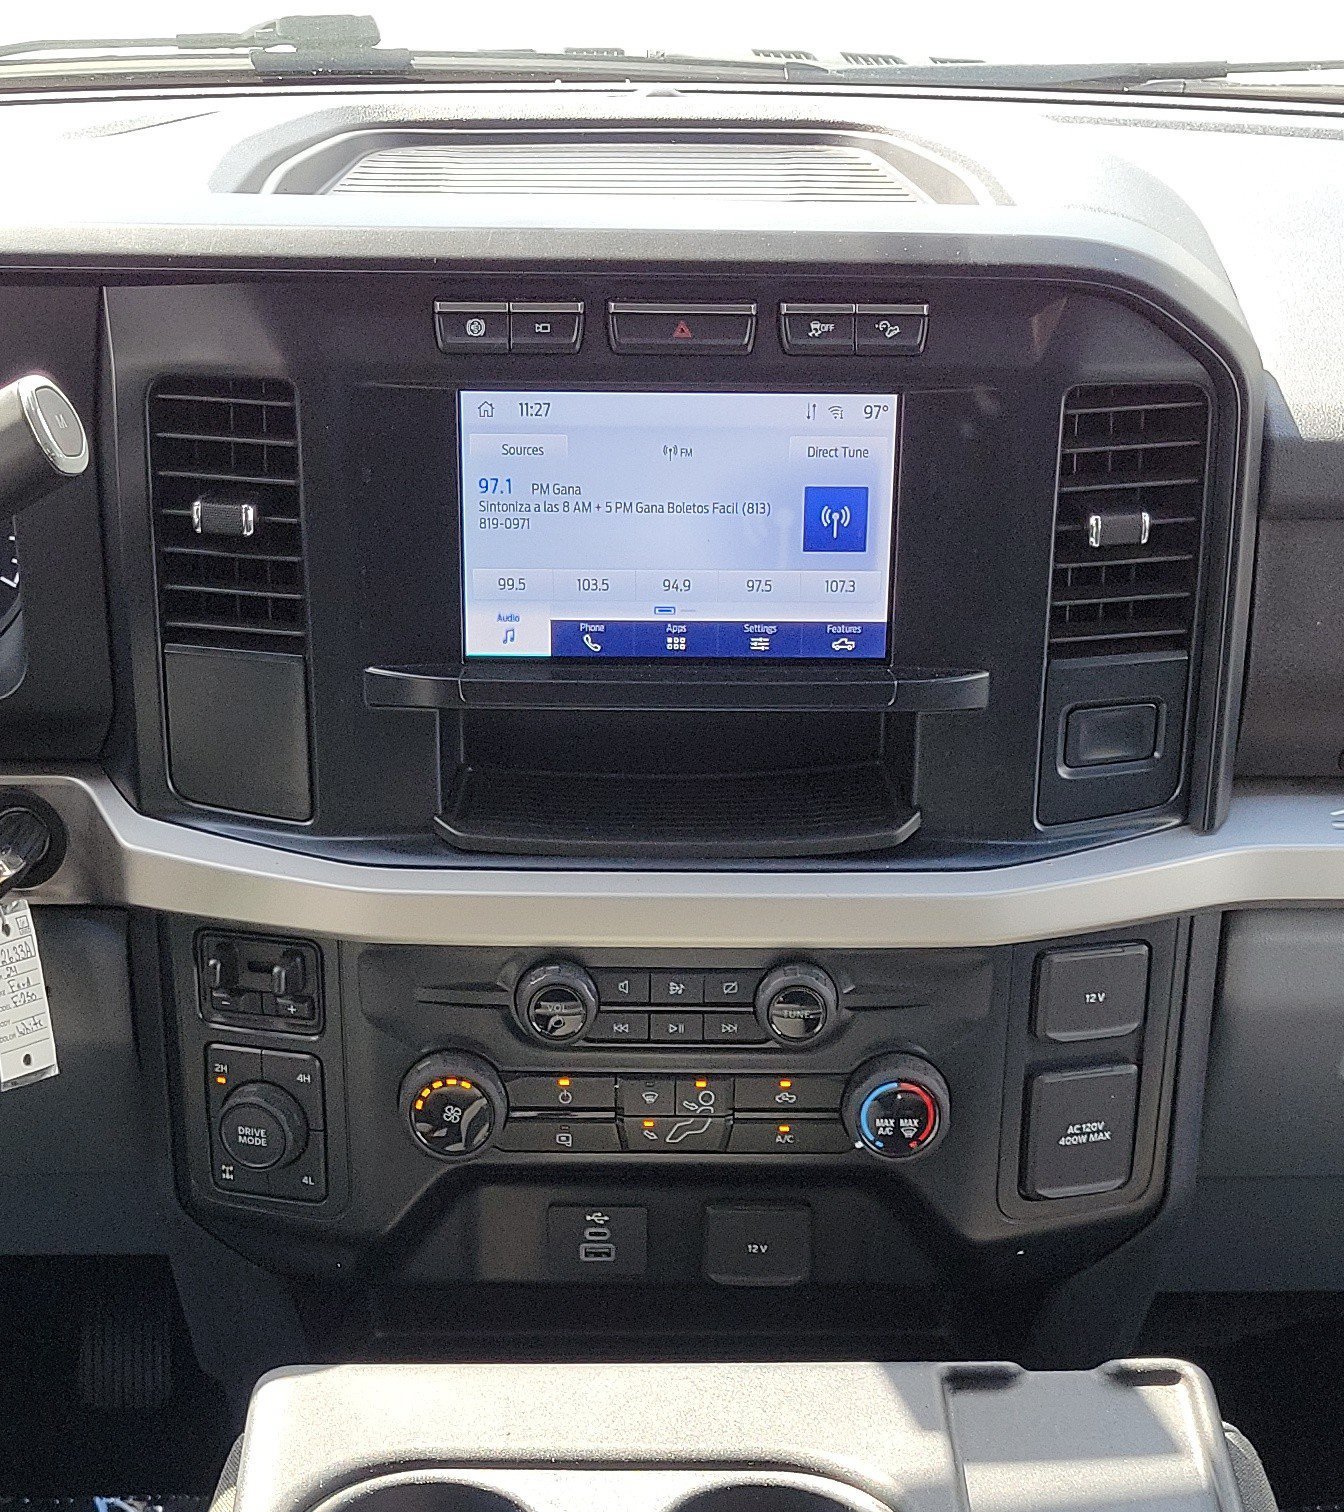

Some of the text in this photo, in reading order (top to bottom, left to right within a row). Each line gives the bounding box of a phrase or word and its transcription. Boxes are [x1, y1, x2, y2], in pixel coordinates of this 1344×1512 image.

[821, 323, 834, 332] OFF
[518, 402, 550, 418] 11:27
[501, 444, 545, 458] Sources
[680, 447, 693, 458] FM
[807, 446, 870, 459] Direct Tune
[478, 478, 582, 496] 97.1 PM Gana
[479, 501, 531, 513] Sintoniza
[534, 503, 541, 513] a
[544, 501, 560, 513] las
[562, 501, 570, 513] 8
[573, 502, 592, 514] AM
[605, 502, 612, 514] 5
[615, 502, 633, 514] PM
[635, 502, 665, 514] Gana
[667, 502, 710, 514] Boletos
[712, 502, 738, 514] Facil
[742, 502, 772, 517] (813)
[479, 517, 530, 530] 819-0971
[498, 578, 526, 591] 99.5
[576, 579, 610, 592] 103.5
[662, 579, 692, 593] 94.9
[746, 579, 772, 594] 97.5
[824, 580, 856, 594] 107.3
[497, 613, 520, 624] Audio
[579, 623, 606, 634] Phone
[666, 624, 687, 636] Apps
[743, 624, 778, 636] Settings
[826, 625, 862, 634] Features
[547, 1004, 568, 1013] VOL
[214, 1064, 228, 1074] 2H
[296, 1074, 311, 1084] 4H
[876, 1118, 896, 1128] MAX
[899, 1118, 919, 1128] MAX
[238, 1126, 266, 1138] DRIVE
[878, 1127, 894, 1136] A/C
[1067, 1124, 1082, 1134] AC
[238, 1136, 268, 1147] MODE
[776, 1135, 795, 1145] A/C
[1058, 1131, 1112, 1146] 400W MAX
[302, 1176, 315, 1186] 4L
